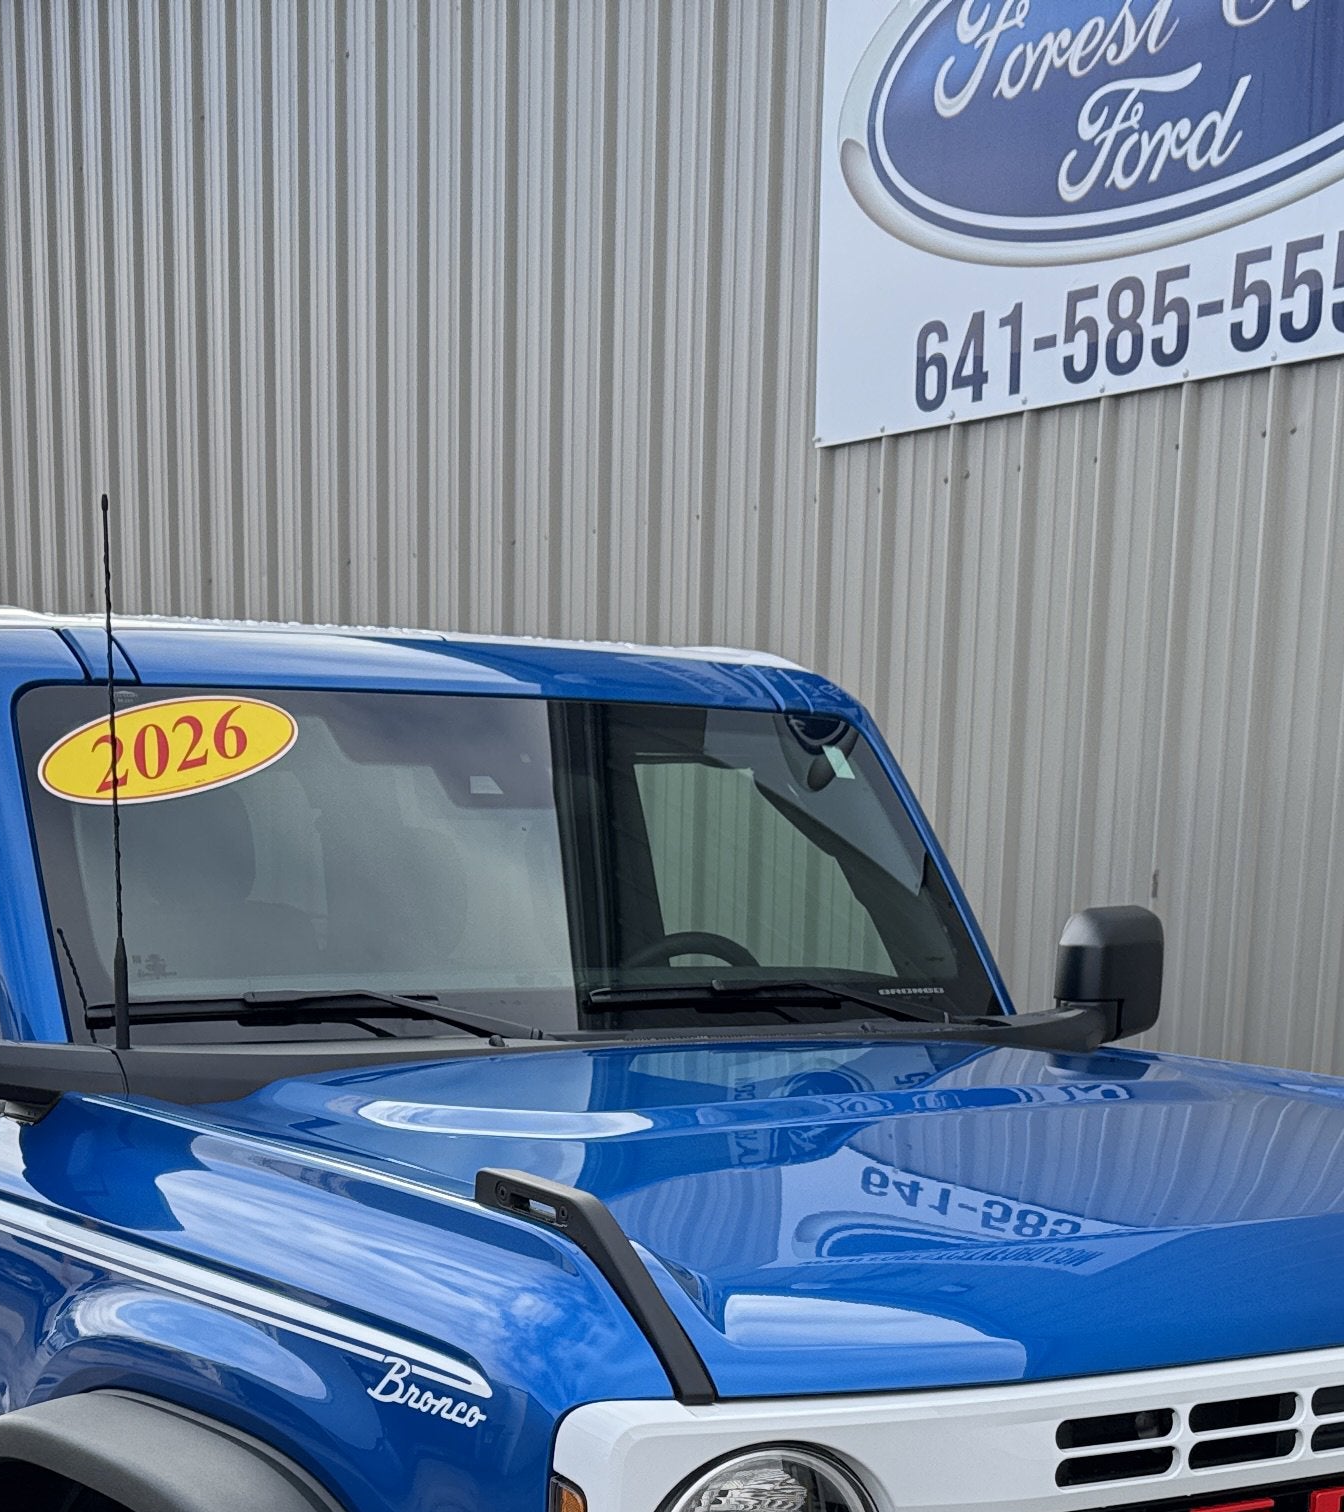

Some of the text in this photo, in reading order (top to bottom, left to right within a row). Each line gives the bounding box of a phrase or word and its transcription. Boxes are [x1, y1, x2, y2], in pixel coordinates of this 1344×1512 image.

[1058, 61, 1253, 203] Ford
[90, 703, 248, 794] 2026
[366, 1355, 487, 1428] Bronco
